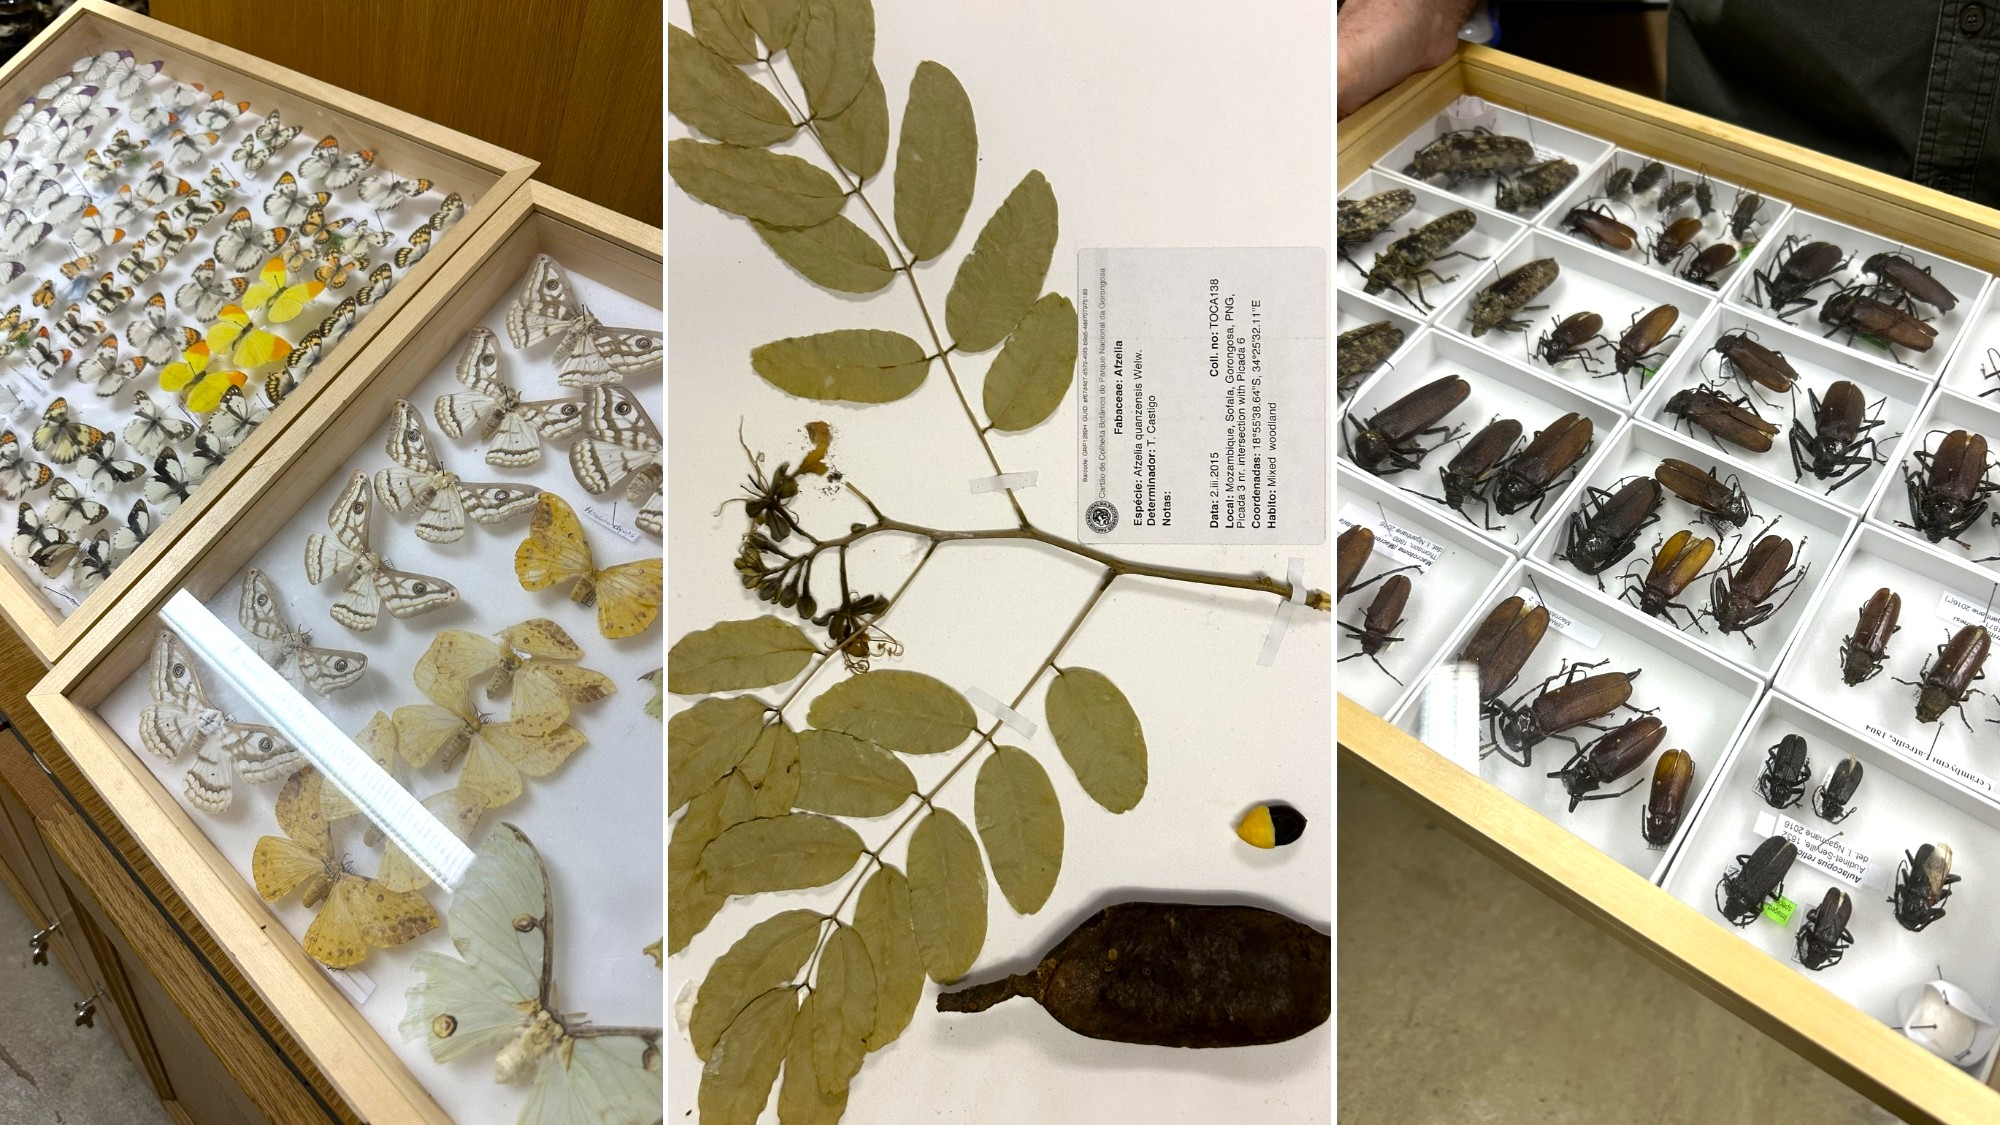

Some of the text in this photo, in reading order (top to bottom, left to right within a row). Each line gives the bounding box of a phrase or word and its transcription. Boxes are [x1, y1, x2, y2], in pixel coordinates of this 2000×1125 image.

[1209, 279, 1218, 329] TOCA138
[1237, 338, 1246, 346] 6
[1210, 353, 1218, 377] Coll.
[1237, 348, 1245, 381] Picada
[1098, 268, 1107, 498] Cartão de Colheita Botânica do Parque Nacional da Gorongosa
[1114, 341, 1123, 434] Fabaceae: Afzelia
[1237, 385, 1245, 405] with
[1225, 294, 1236, 528] Local: Mozambique, Sofala, Gorongosa, PNG,
[1133, 350, 1144, 525] Espécie: Afzelia quanzensis Welw.
[1237, 408, 1245, 465] intersection
[1147, 395, 1158, 526] Determinador: T. Castigo
[1267, 403, 1276, 528] Habito: Mixed woodland
[1210, 452, 1219, 528] Data: 2.iii.2015
[1252, 454, 1260, 528] Coordenadas:
[1162, 492, 1171, 526] Notas:
[1237, 494, 1245, 528] Picada
[1378, 519, 1396, 532] 2016
[1392, 534, 1438, 560] Thomson, 1860
[1431, 543, 1443, 553] det.
[1864, 723, 1887, 739] 1804
[1930, 756, 1993, 791] Cerambycini
[1780, 829, 1801, 844] 1832
[1782, 819, 1804, 834] 2016
[1815, 857, 1862, 884] Aulacopus
[1851, 850, 1869, 864] det.
